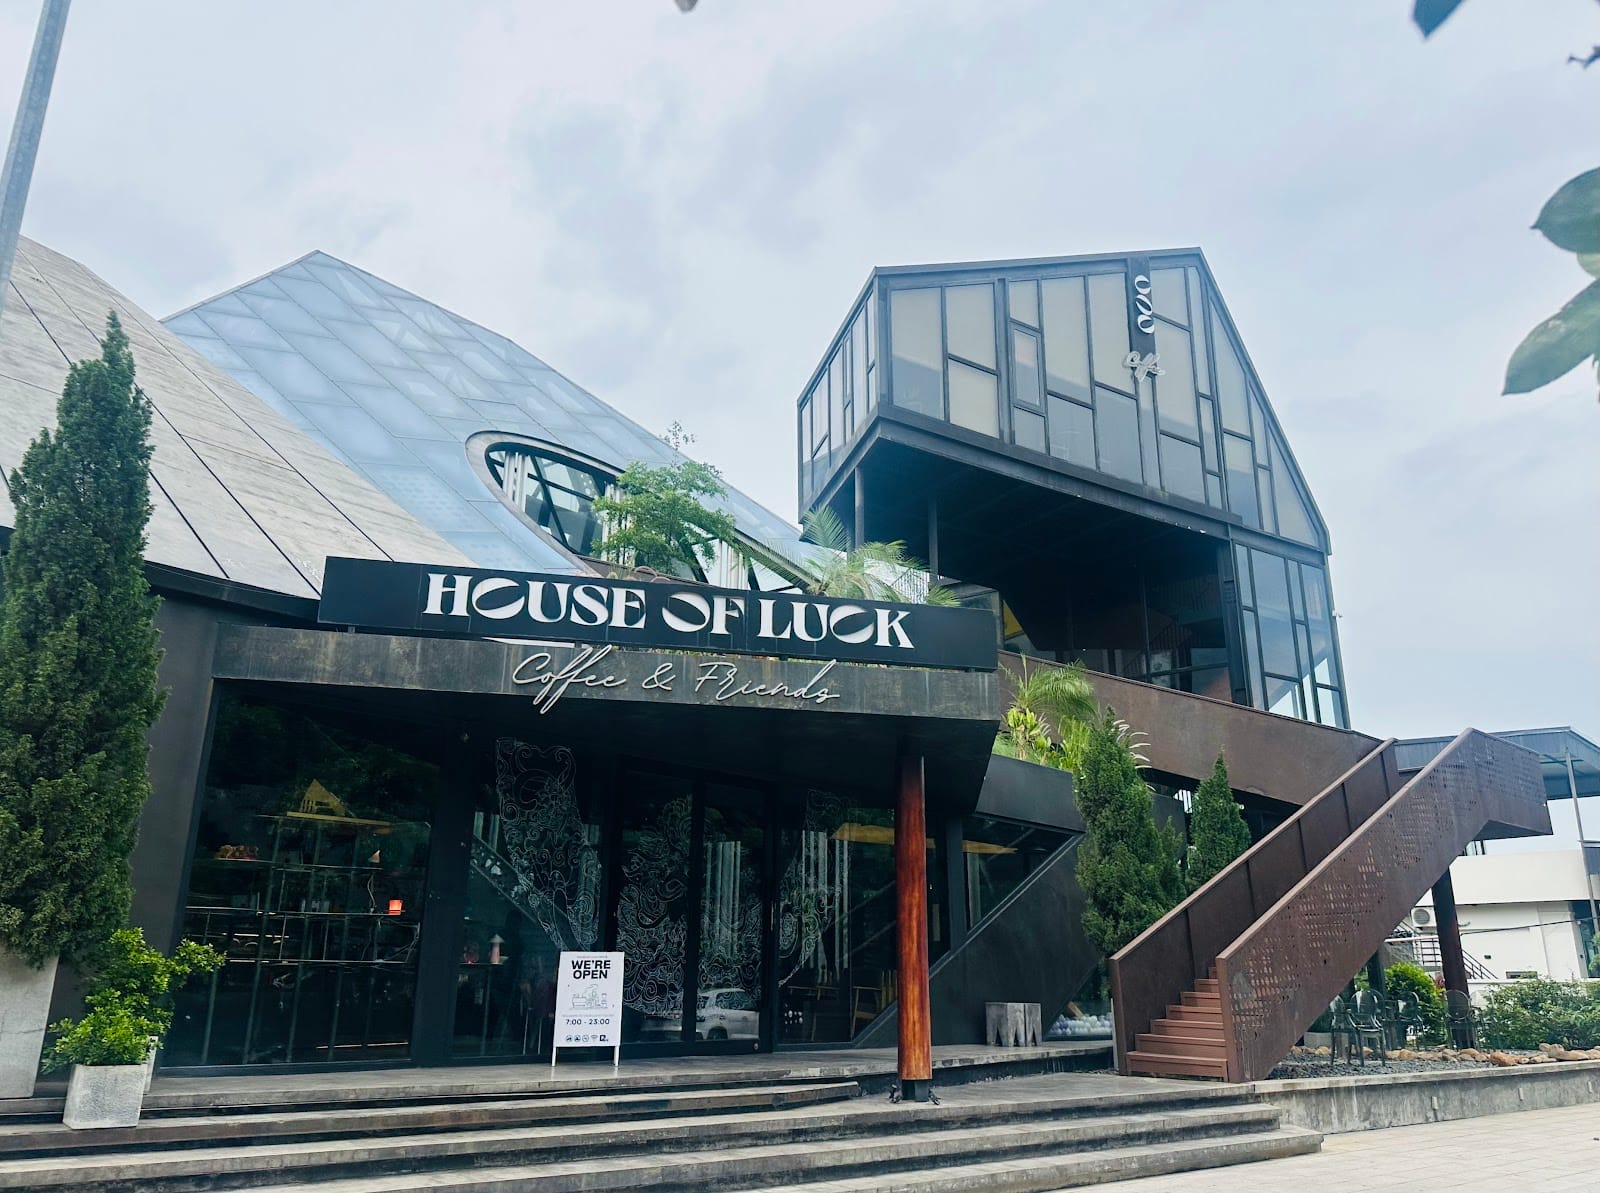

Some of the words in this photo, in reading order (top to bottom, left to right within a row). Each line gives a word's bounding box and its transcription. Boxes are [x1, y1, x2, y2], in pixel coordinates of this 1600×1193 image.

[422, 573, 647, 629] HOUSE
[661, 591, 746, 635] OF
[756, 598, 915, 649] LUCK
[512, 644, 627, 714] Coffee
[641, 662, 677, 691] &
[694, 658, 841, 704] Friends
[571, 959, 611, 970] WE'RE
[572, 969, 608, 980] OPEN
